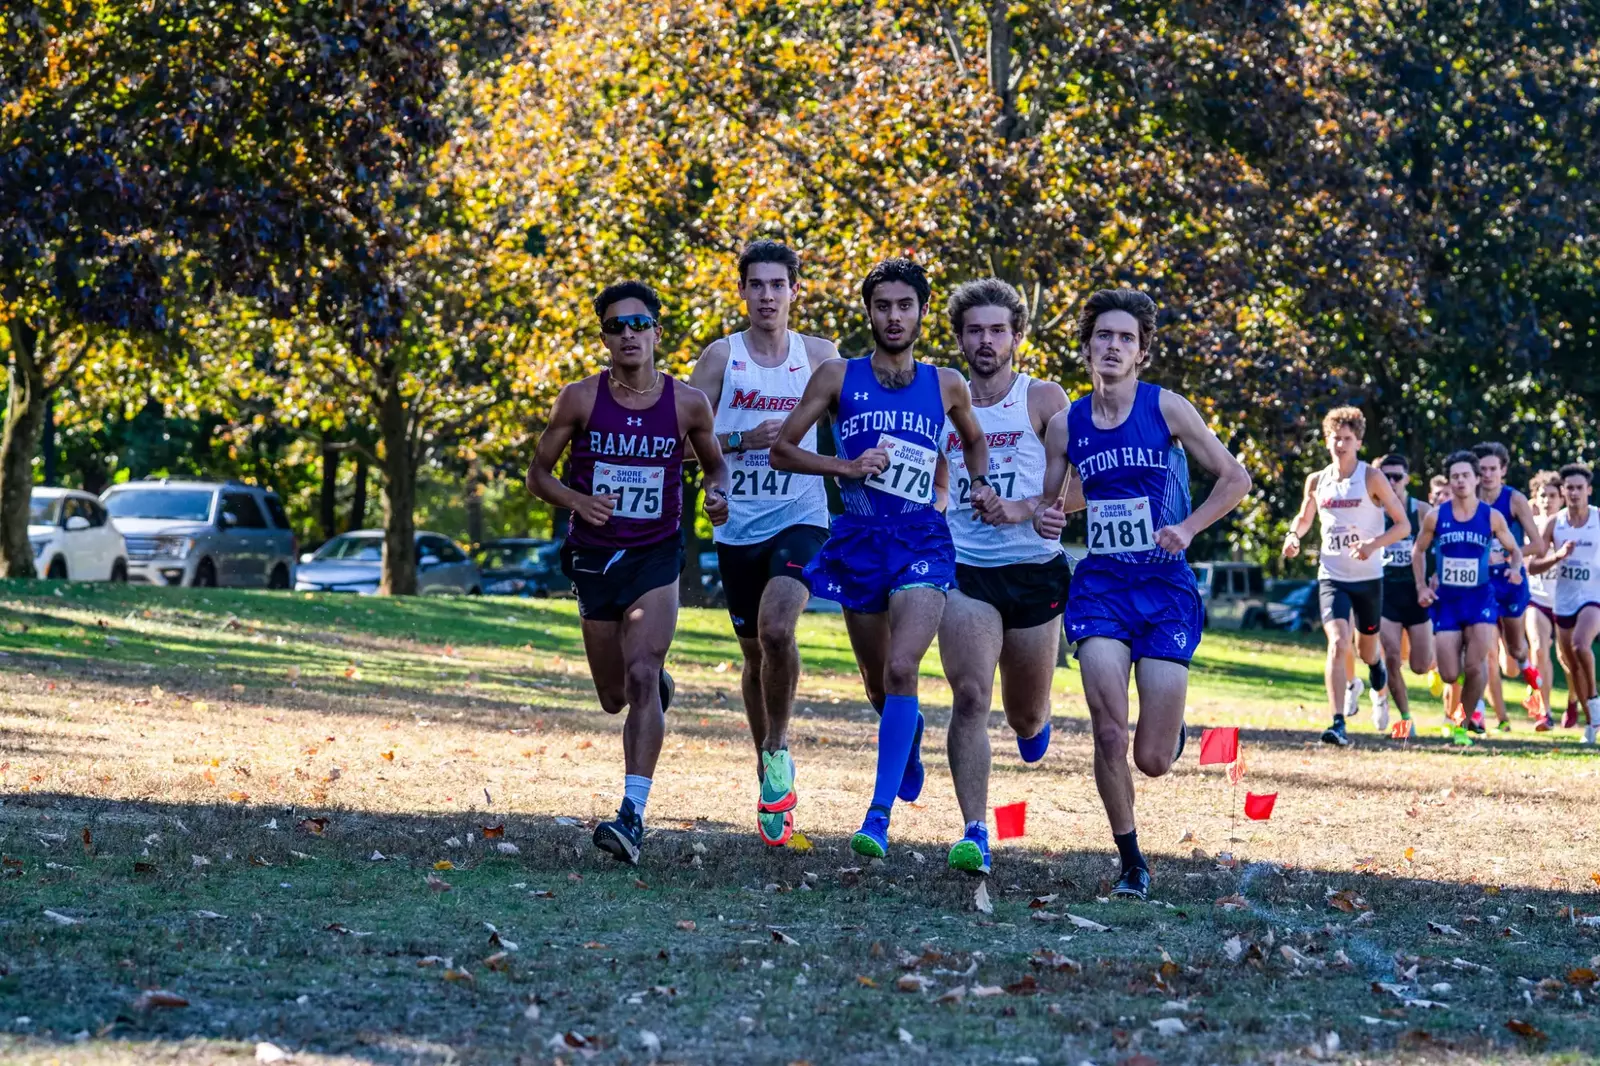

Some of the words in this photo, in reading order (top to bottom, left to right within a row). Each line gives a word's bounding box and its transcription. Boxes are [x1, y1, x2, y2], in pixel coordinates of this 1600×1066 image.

[729, 388, 800, 412] MARIS
[841, 410, 896, 440] SETON
[901, 411, 939, 446] HALL
[589, 431, 676, 458] RAMAPO
[901, 445, 924, 457] SHORE
[946, 431, 1024, 453] MIST
[749, 453, 770, 461] SHOR
[894, 450, 926, 466] COACHES
[1077, 447, 1118, 481] ETON
[1121, 447, 1167, 469] HALL
[611, 476, 647, 484] COACHES
[732, 469, 793, 496] 2147
[958, 472, 1016, 504] 257
[1100, 510, 1132, 518] COACHES
[1090, 518, 1149, 548] 2181
[1444, 568, 1476, 583] 2180
[1561, 566, 1590, 581] 2120
